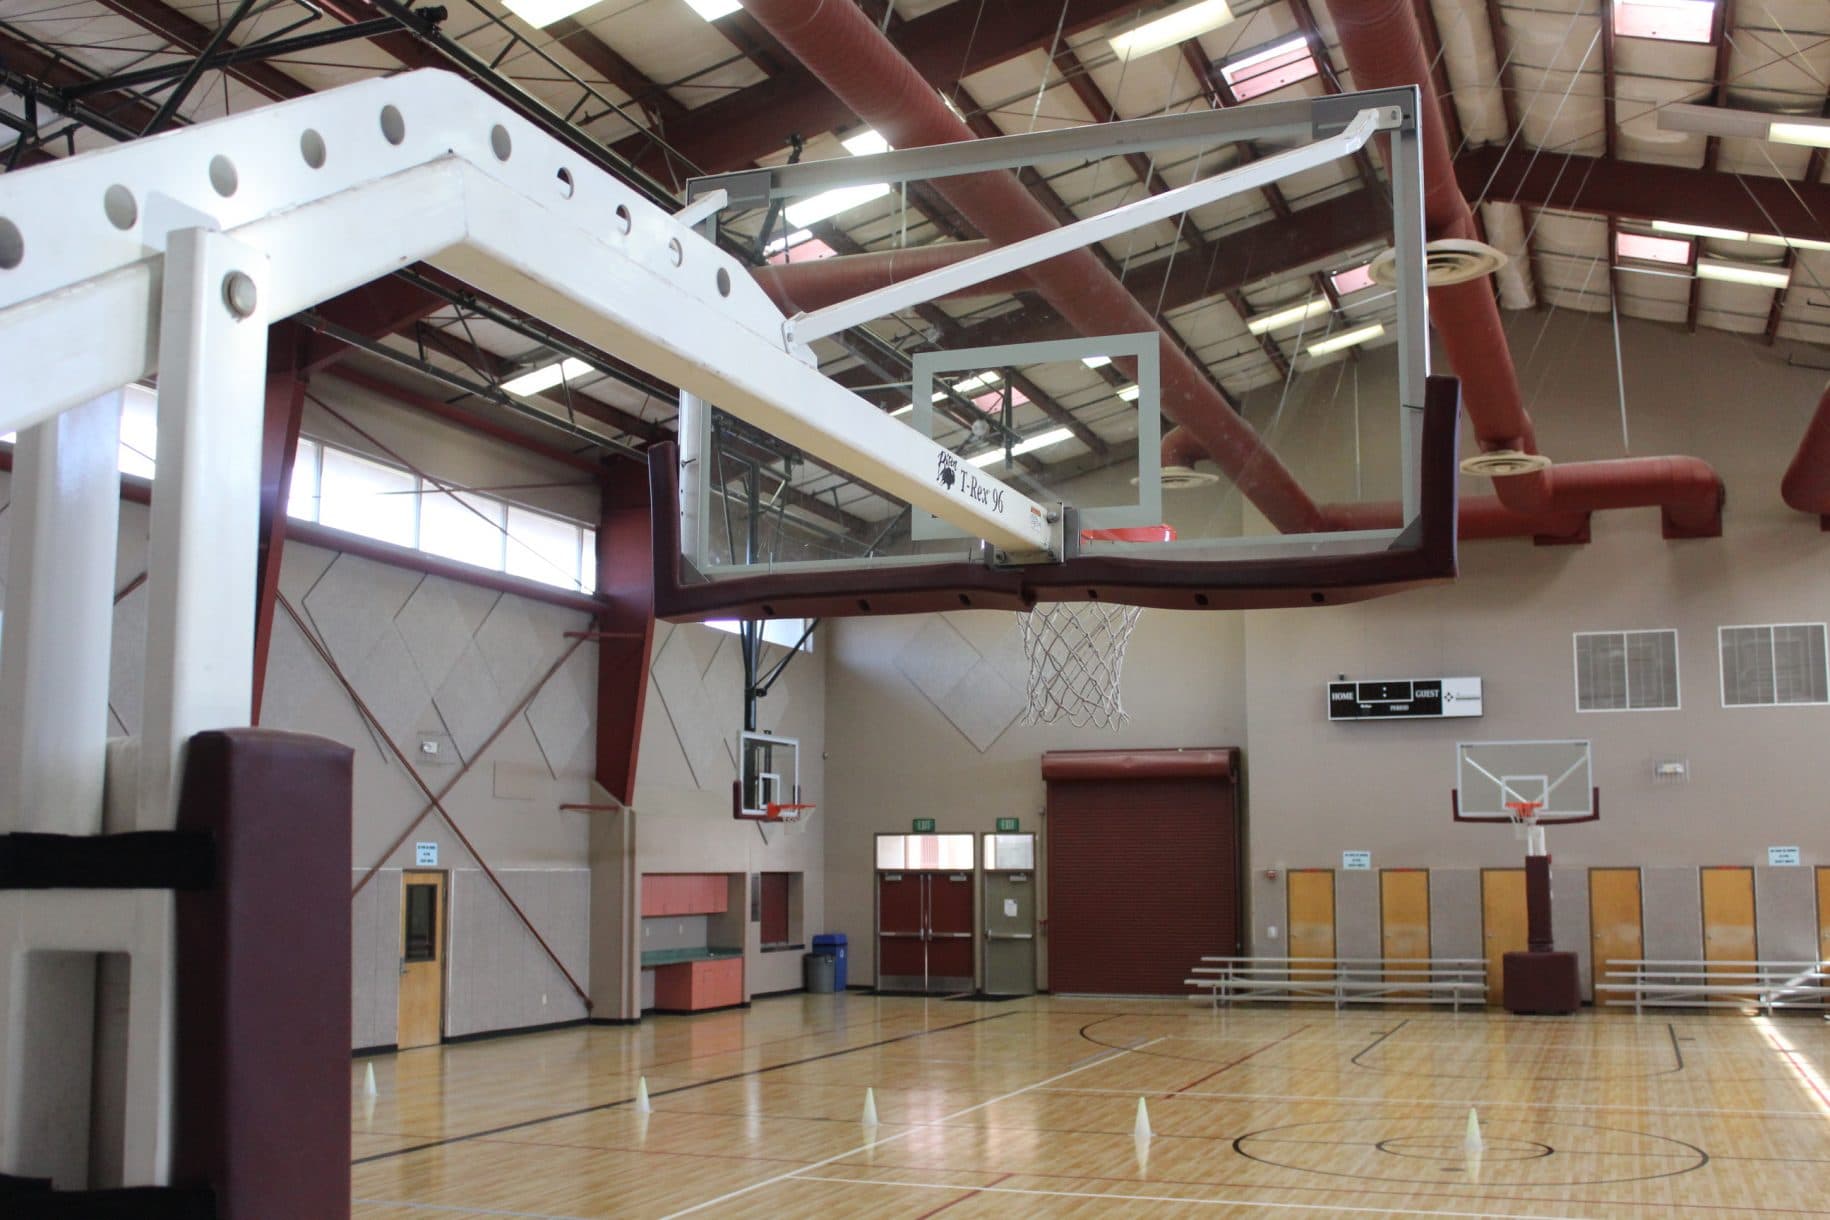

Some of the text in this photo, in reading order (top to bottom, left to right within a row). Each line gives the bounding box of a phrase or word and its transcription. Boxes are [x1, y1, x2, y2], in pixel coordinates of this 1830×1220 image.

[960, 469, 1004, 514] T-Rex 96
[1331, 691, 1355, 701] HOME
[1415, 689, 1440, 698] GUEST
